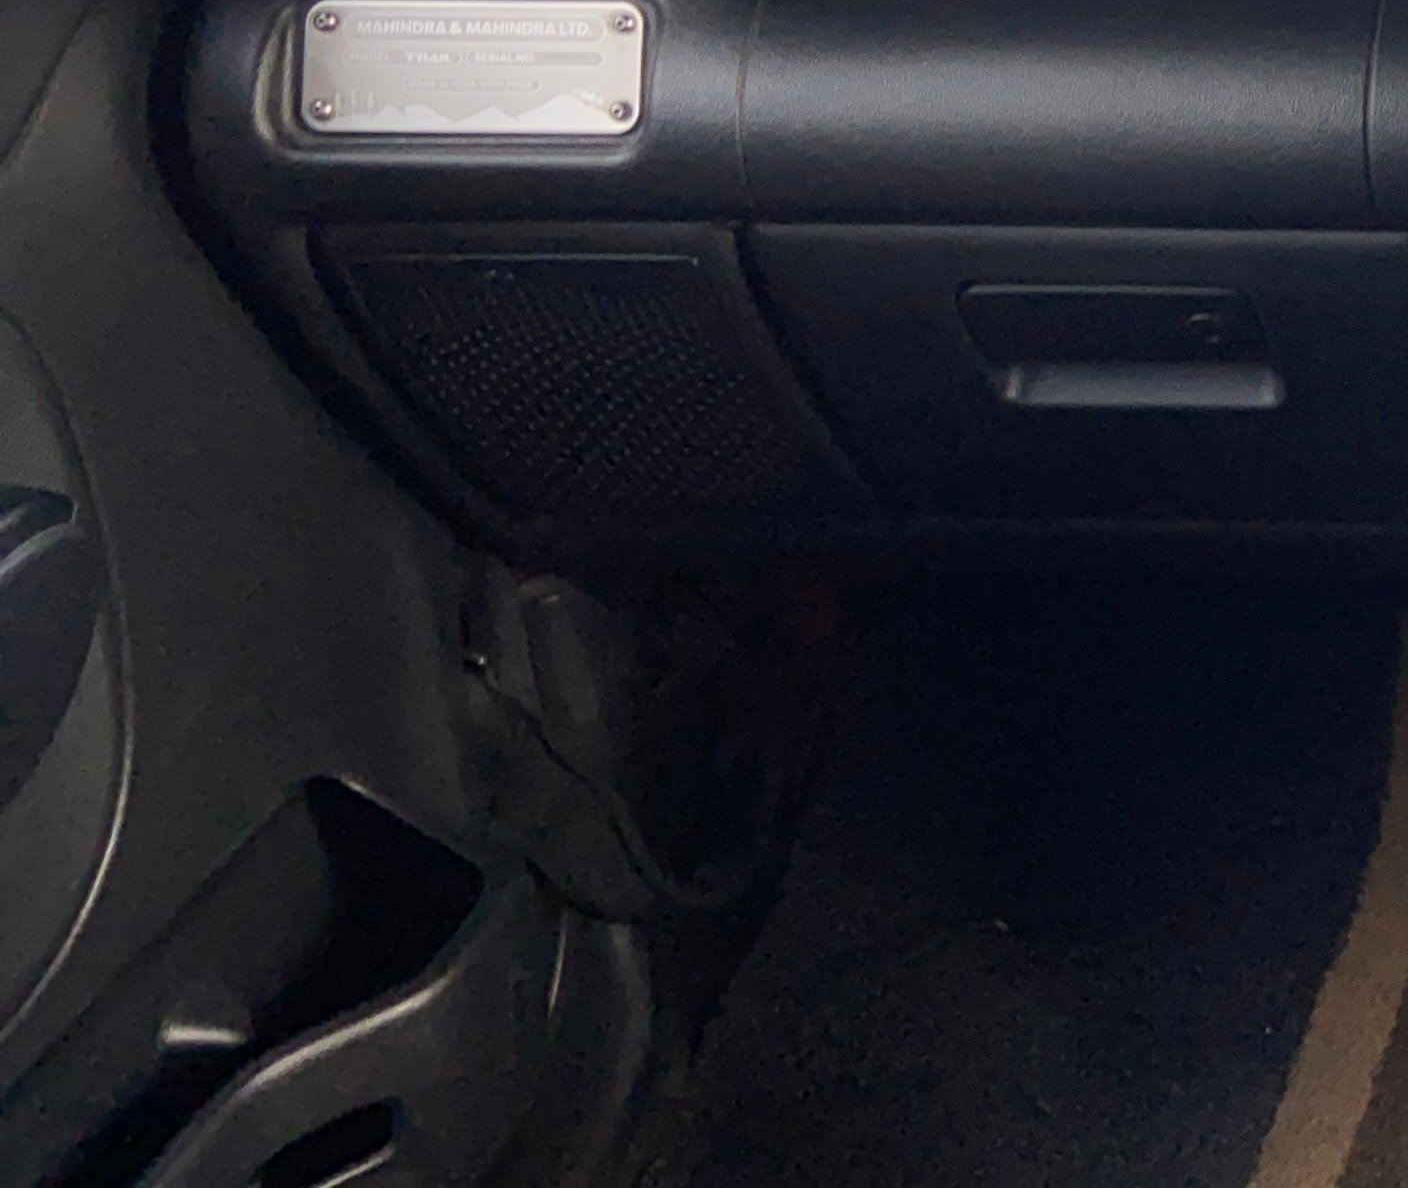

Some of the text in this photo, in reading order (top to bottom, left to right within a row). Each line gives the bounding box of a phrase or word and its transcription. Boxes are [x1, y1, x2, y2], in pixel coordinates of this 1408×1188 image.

[357, 19, 593, 37] MAHINDRA & MAHINDRA LTD.
